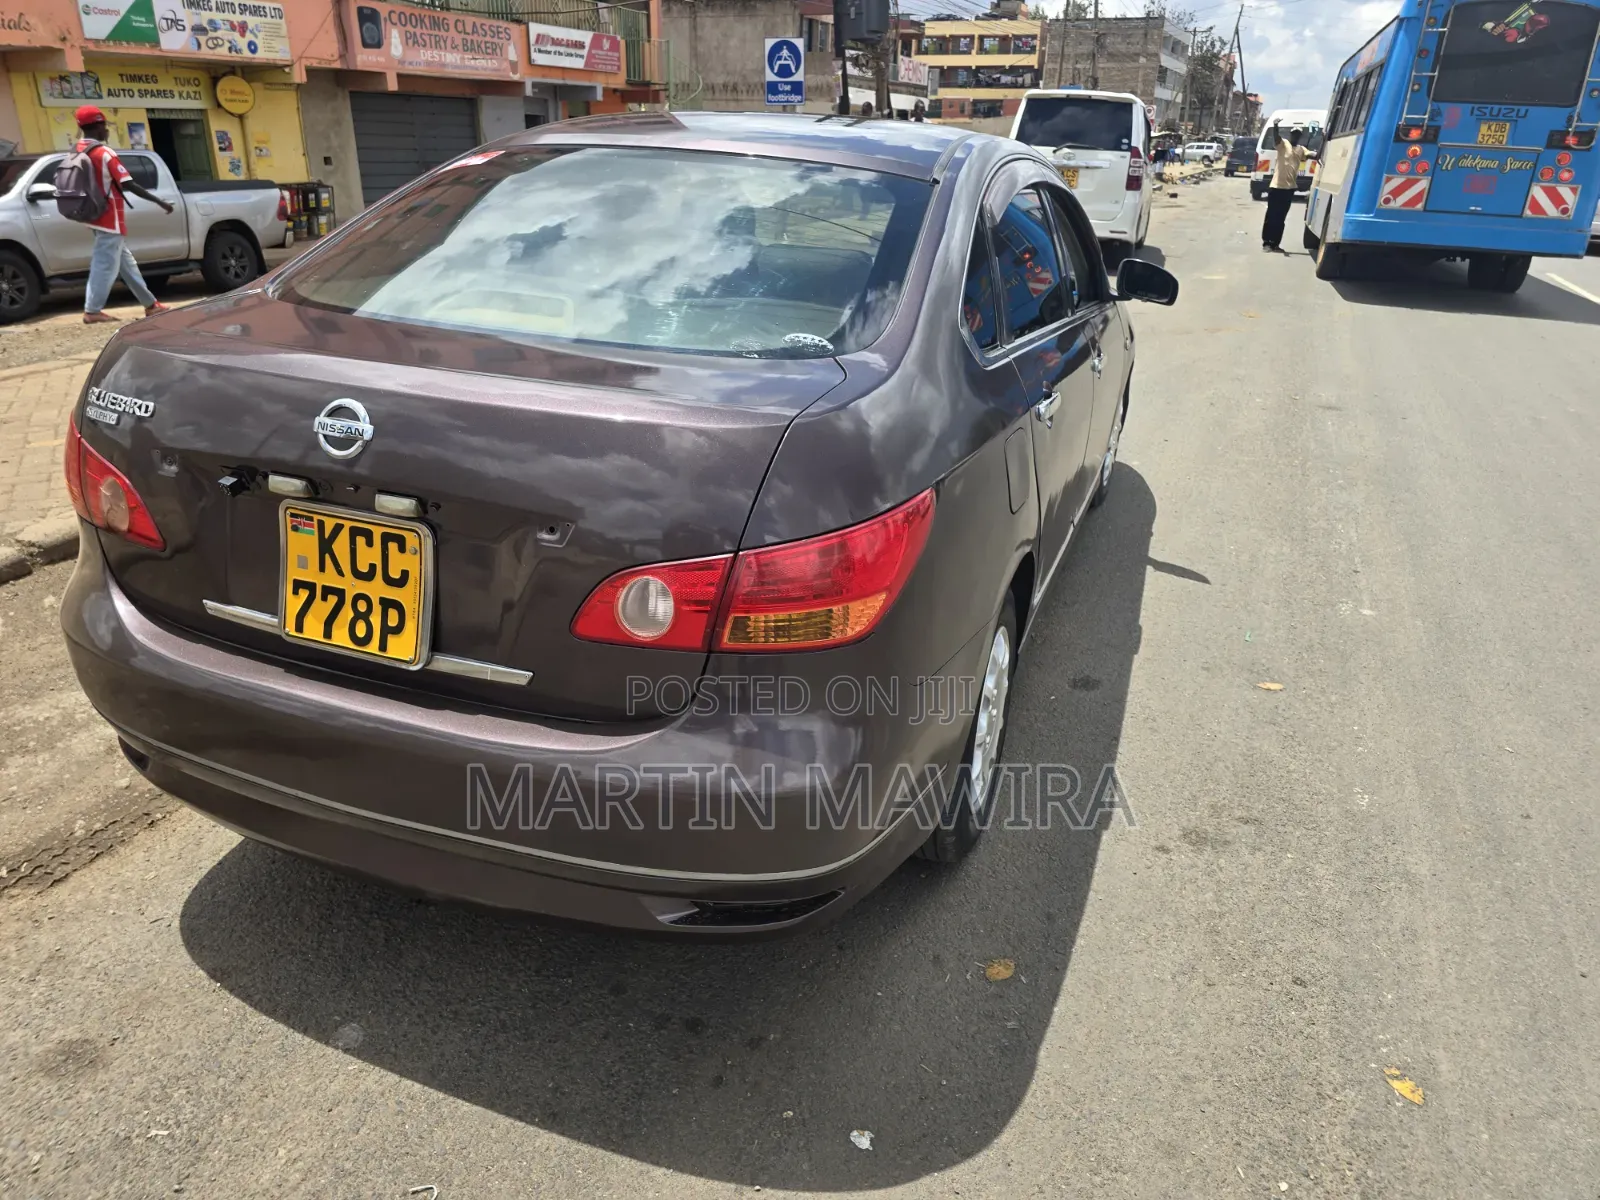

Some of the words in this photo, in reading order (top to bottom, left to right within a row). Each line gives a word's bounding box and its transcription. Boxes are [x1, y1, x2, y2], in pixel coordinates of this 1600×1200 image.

[92, 7, 120, 16] Castrol
[182, 0, 214, 12] TIMKEG
[215, 0, 237, 15] AUTO
[238, 3, 268, 19] SPARES
[268, 6, 284, 20] LTD
[388, 10, 450, 32] COOKING
[454, 19, 511, 41] CLASSES
[405, 30, 449, 50] PASTRY
[451, 37, 460, 51] &
[462, 38, 504, 57] BAKERY
[420, 50, 461, 64] DESTINY
[537, 47, 553, 56] Member
[118, 73, 159, 85] TIMKEG
[174, 76, 201, 88] TUKO
[778, 83, 791, 92] Use
[107, 88, 135, 99] AUTO
[138, 88, 175, 100] SPARES
[178, 90, 202, 101] KAZI
[768, 92, 803, 103] footbridge
[1469, 106, 1530, 119] ISUZU
[1486, 123, 1507, 133] KDB
[1478, 133, 1505, 144] 375Q
[1500, 156, 1536, 174] Sacco
[86, 406, 115, 424] SYLPHY
[317, 420, 365, 438] NISSAN
[317, 519, 410, 588] KCC
[292, 578, 406, 653] 778P
